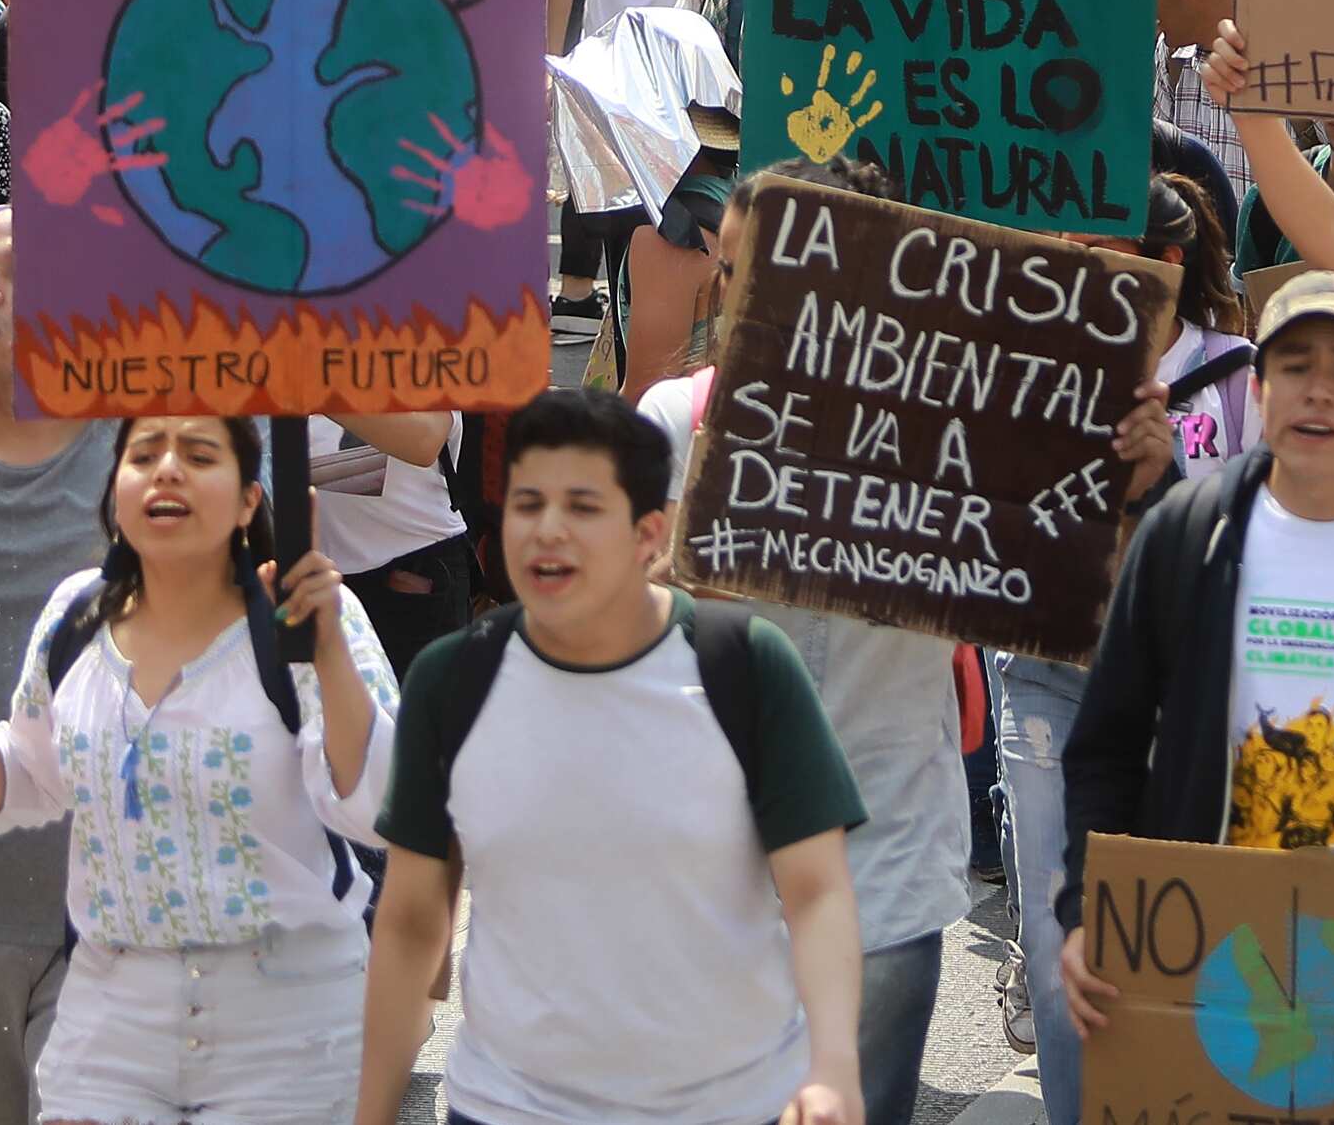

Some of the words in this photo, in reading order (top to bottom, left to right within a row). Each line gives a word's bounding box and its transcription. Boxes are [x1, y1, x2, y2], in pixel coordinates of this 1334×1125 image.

[903, 57, 980, 131] ES
[1000, 57, 1104, 135] LO
[771, 198, 840, 273] LA
[890, 227, 1140, 345] CRISIS
[61, 349, 271, 396] NUESTRO
[322, 346, 489, 391] FUTURO
[787, 290, 1115, 437] AMBIENTAL
[724, 380, 815, 457] SE
[845, 401, 902, 467] VA
[937, 416, 977, 489] A
[728, 449, 1002, 562] DETENER
[1094, 876, 1206, 977] NO
